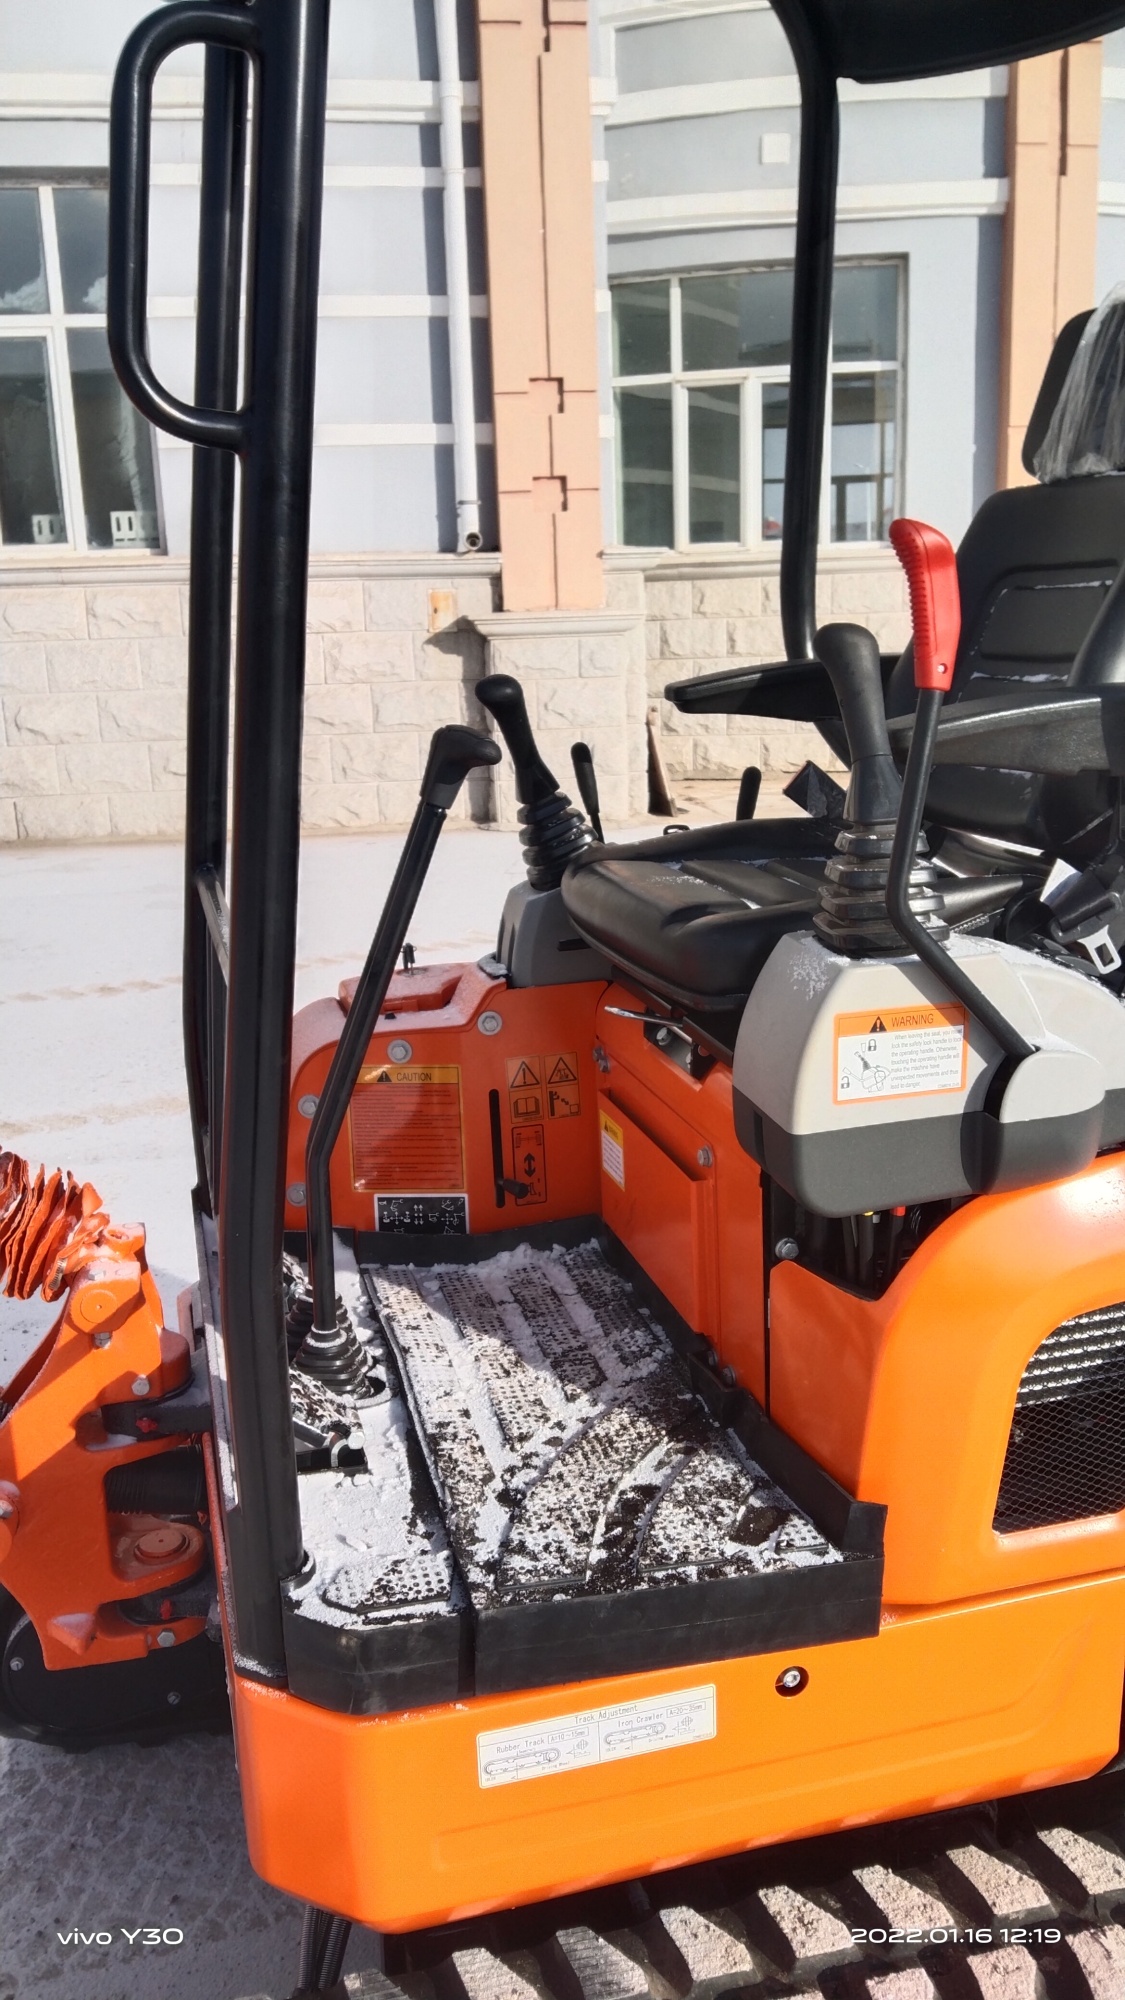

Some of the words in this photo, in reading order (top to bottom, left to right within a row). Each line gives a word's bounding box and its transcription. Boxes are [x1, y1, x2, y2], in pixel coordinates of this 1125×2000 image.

[892, 1014, 934, 1027] WARNING
[397, 1073, 431, 1081] CAUTION
[575, 1714, 595, 1724] Track
[598, 1705, 638, 1719] Adjustment
[637, 1713, 663, 1723] Crawler
[496, 1744, 520, 1754] Rubber
[525, 1738, 545, 1747] Track
